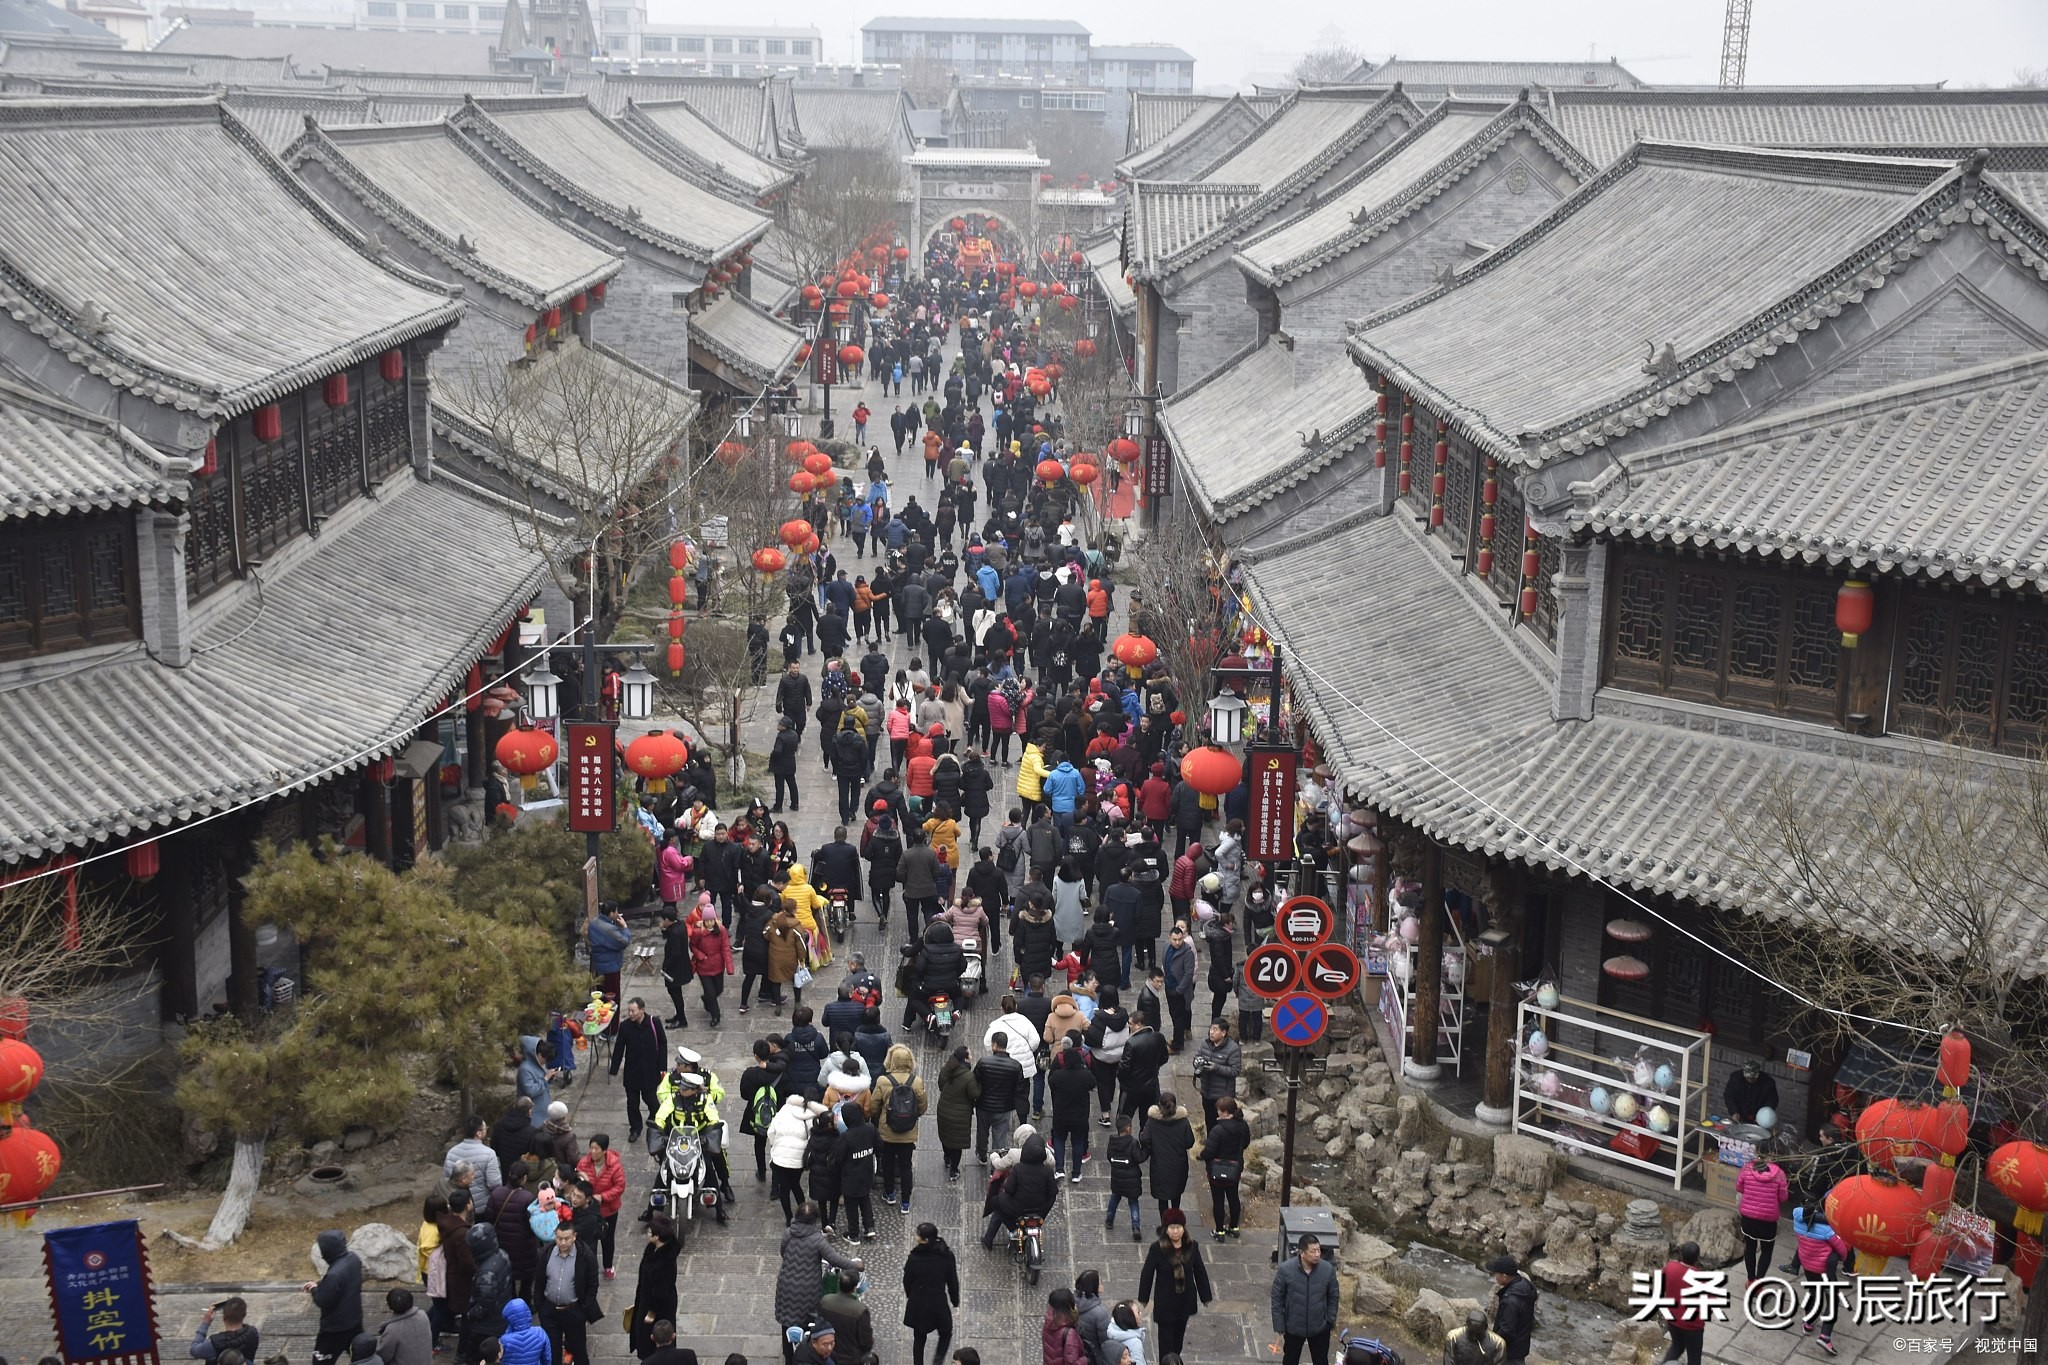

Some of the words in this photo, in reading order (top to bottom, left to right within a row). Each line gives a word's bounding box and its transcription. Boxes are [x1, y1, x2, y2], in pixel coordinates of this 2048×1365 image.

[580, 755, 590, 817] 推动旅游发展
[593, 755, 602, 817] 服务八方游客
[1260, 771, 1271, 855] 打造5A级旅游党建示范区
[1258, 956, 1288, 982] 20
[82, 1287, 126, 1351] 抖空竹
